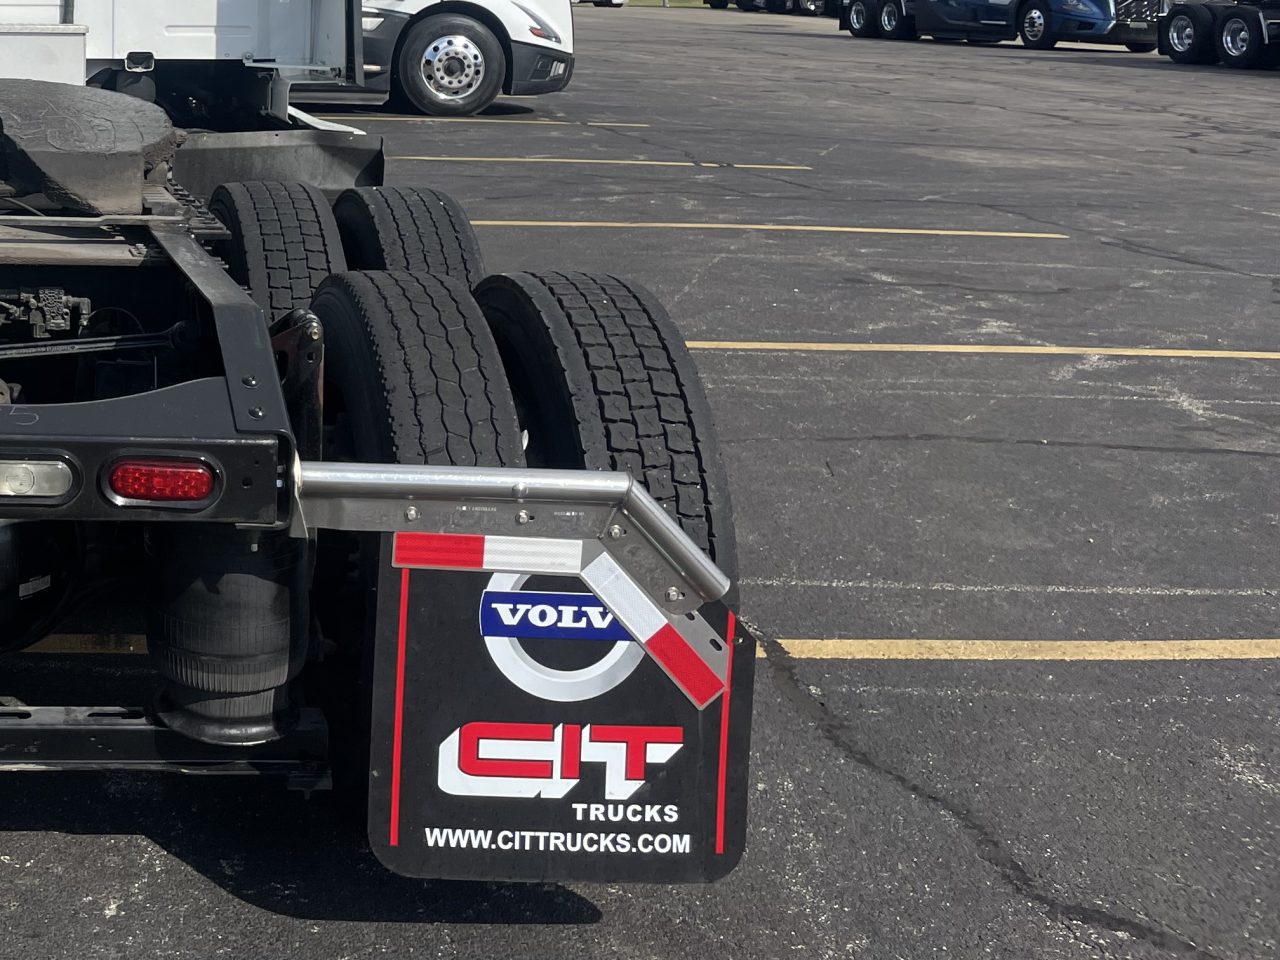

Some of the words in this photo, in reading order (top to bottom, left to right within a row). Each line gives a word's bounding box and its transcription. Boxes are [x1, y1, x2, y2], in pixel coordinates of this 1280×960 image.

[491, 603, 613, 628] VOLV
[438, 722, 684, 800] CIT
[571, 803, 679, 822] TRUCKS
[424, 827, 691, 854] WWW.CITTRUCKS.COM
